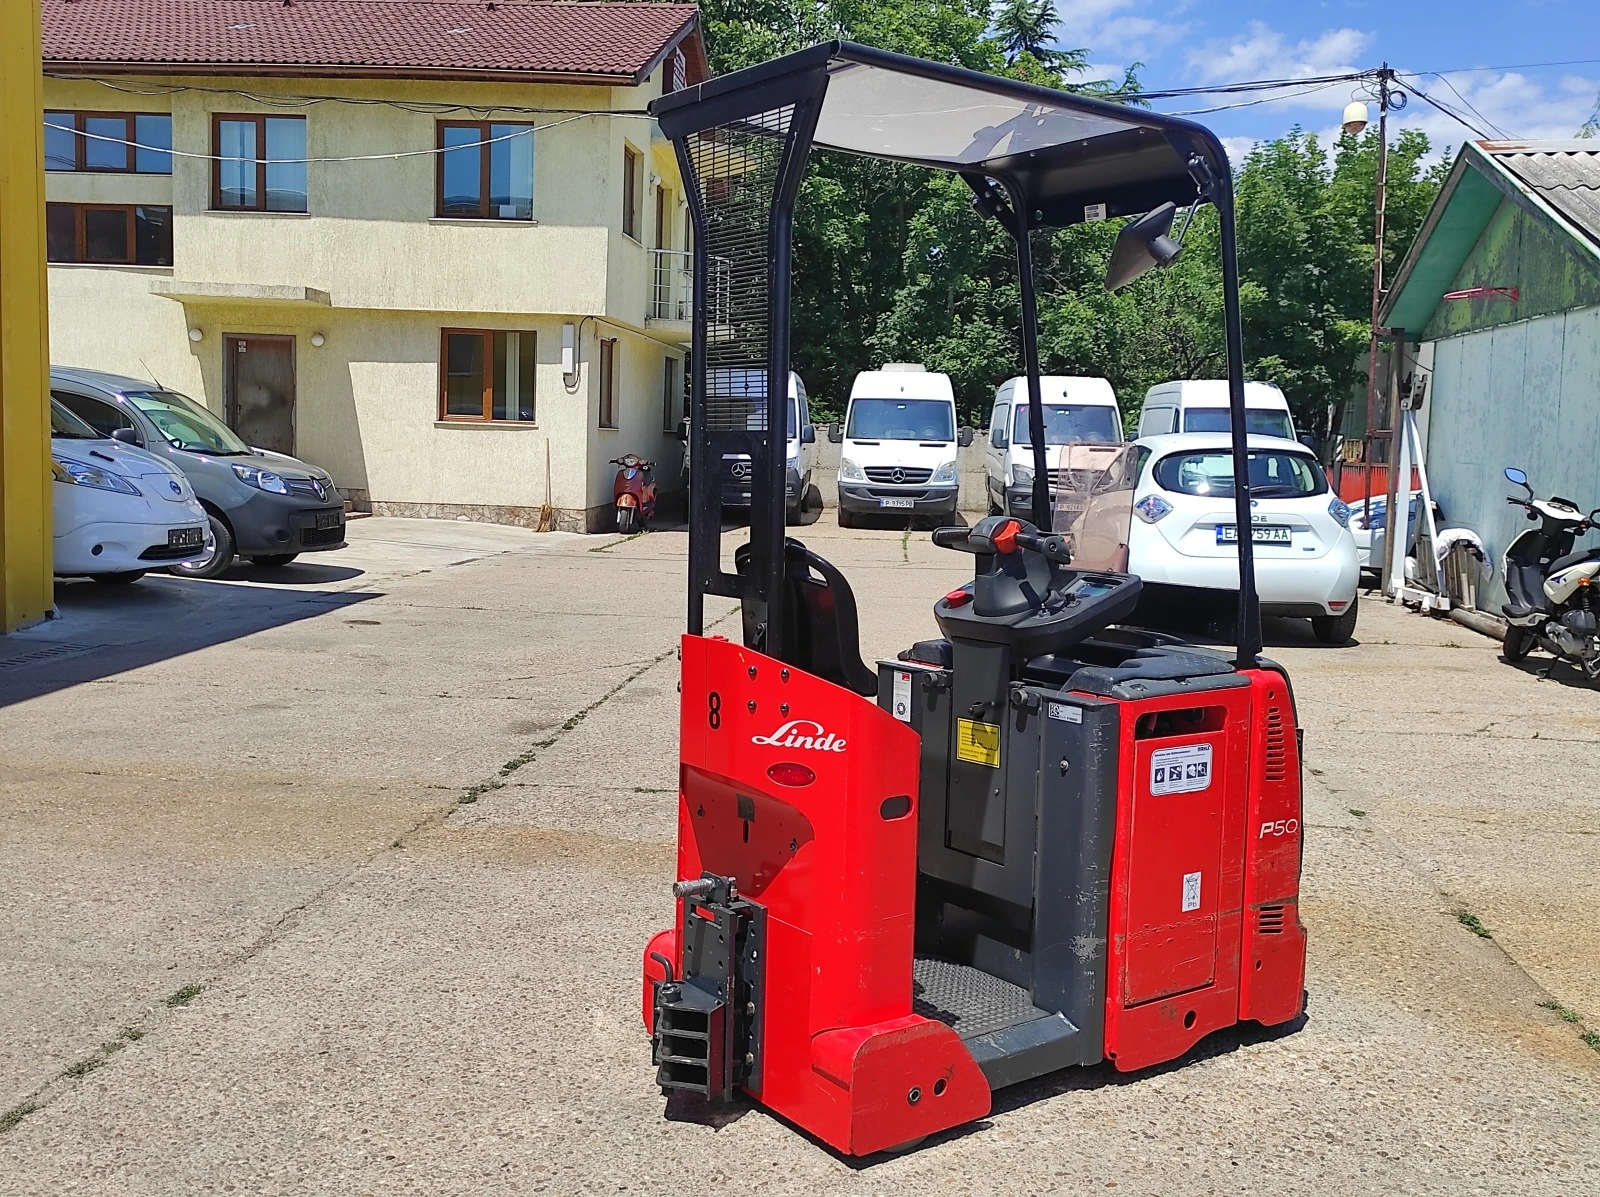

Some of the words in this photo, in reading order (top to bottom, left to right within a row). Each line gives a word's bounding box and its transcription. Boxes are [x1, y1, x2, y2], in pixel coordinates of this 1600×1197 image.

[1273, 529, 1288, 540] AA
[708, 691, 721, 730] 8
[751, 719, 847, 753] Linde
[1259, 818, 1298, 839] P50
[1187, 901, 1198, 909] Pb
